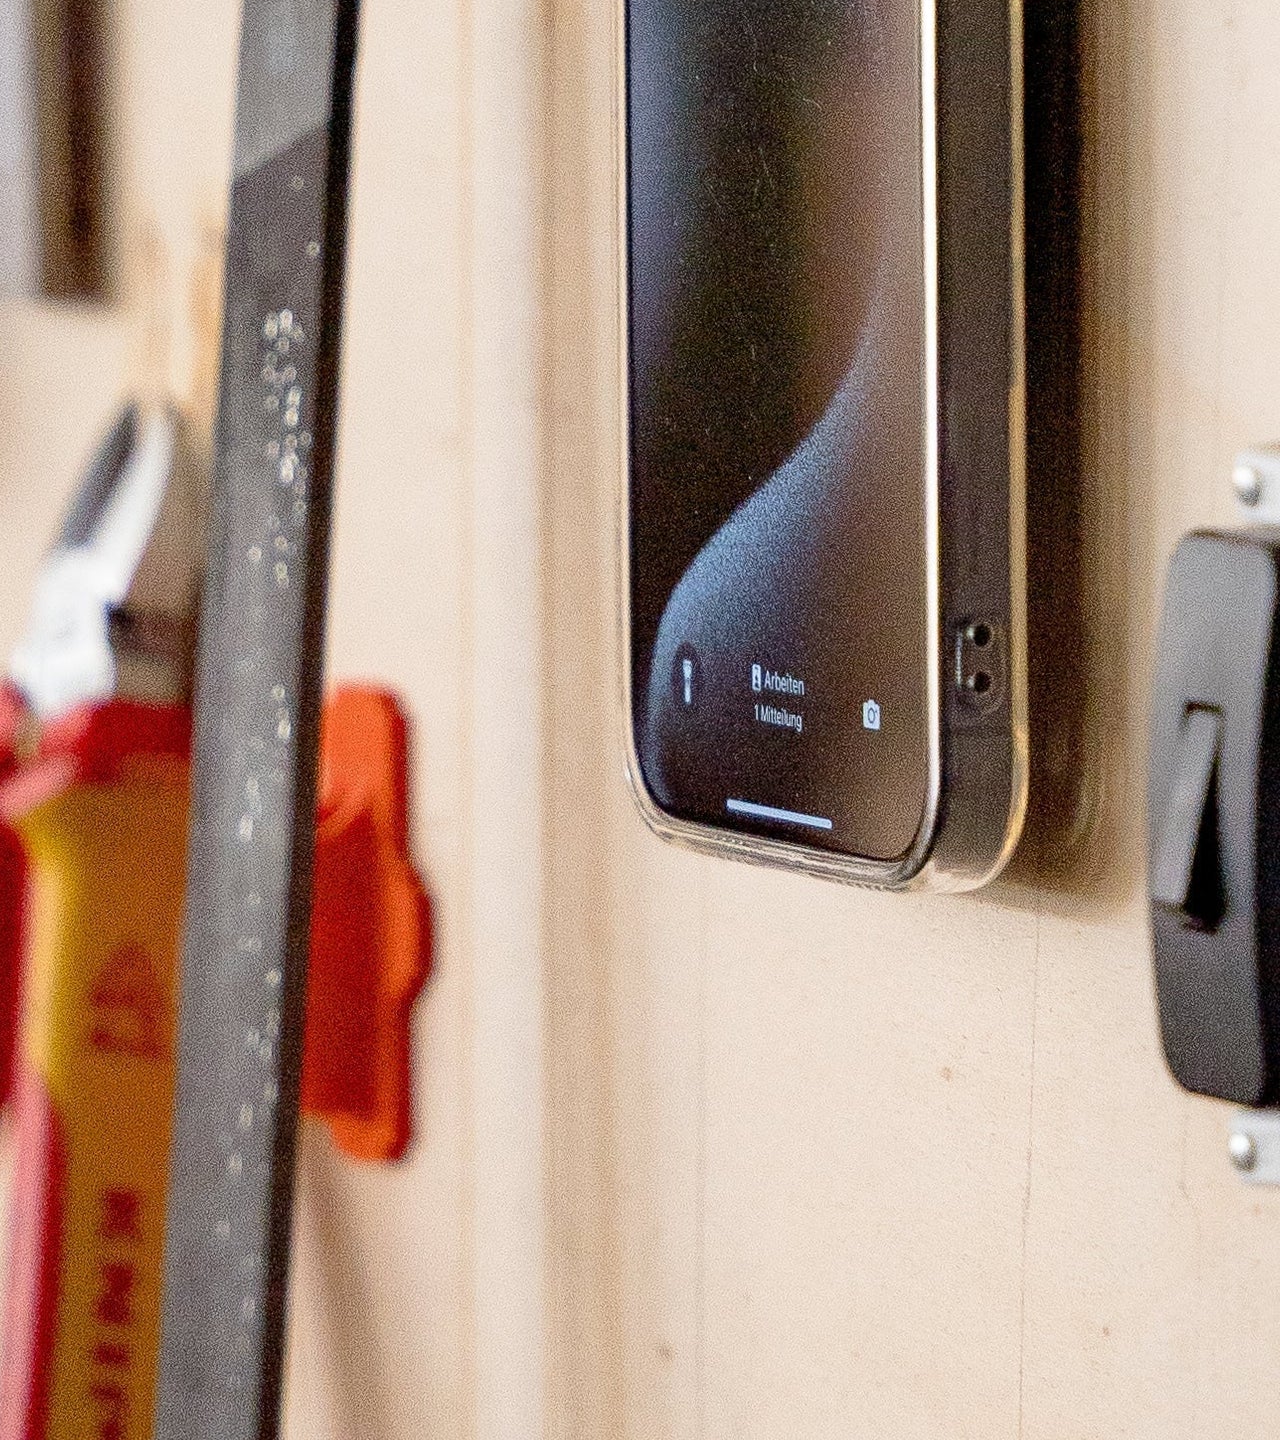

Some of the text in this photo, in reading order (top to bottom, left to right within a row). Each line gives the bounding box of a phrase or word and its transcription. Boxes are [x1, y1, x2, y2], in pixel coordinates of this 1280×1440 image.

[764, 670, 805, 695] Arbeiten
[754, 704, 802, 732] 1 Mitteilung
